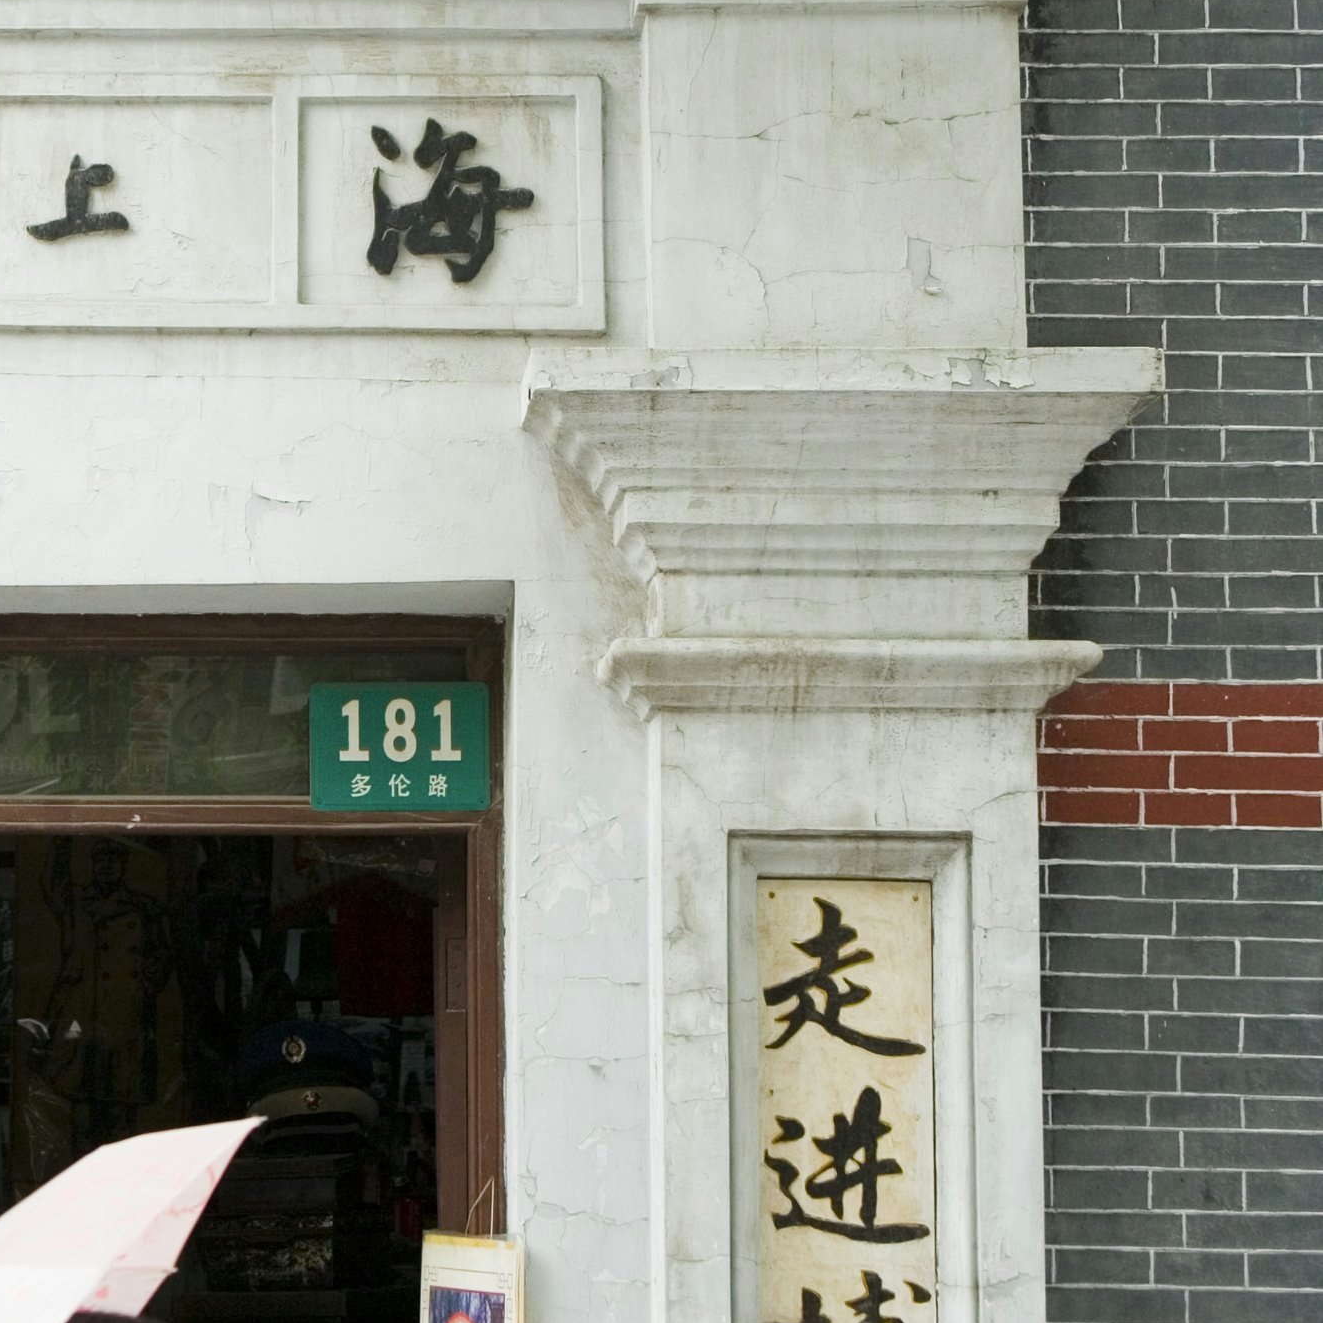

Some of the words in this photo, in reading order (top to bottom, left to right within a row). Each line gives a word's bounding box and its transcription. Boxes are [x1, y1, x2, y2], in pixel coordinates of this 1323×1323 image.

[339, 698, 462, 762] 181
[350, 773, 448, 797] 多伦路
